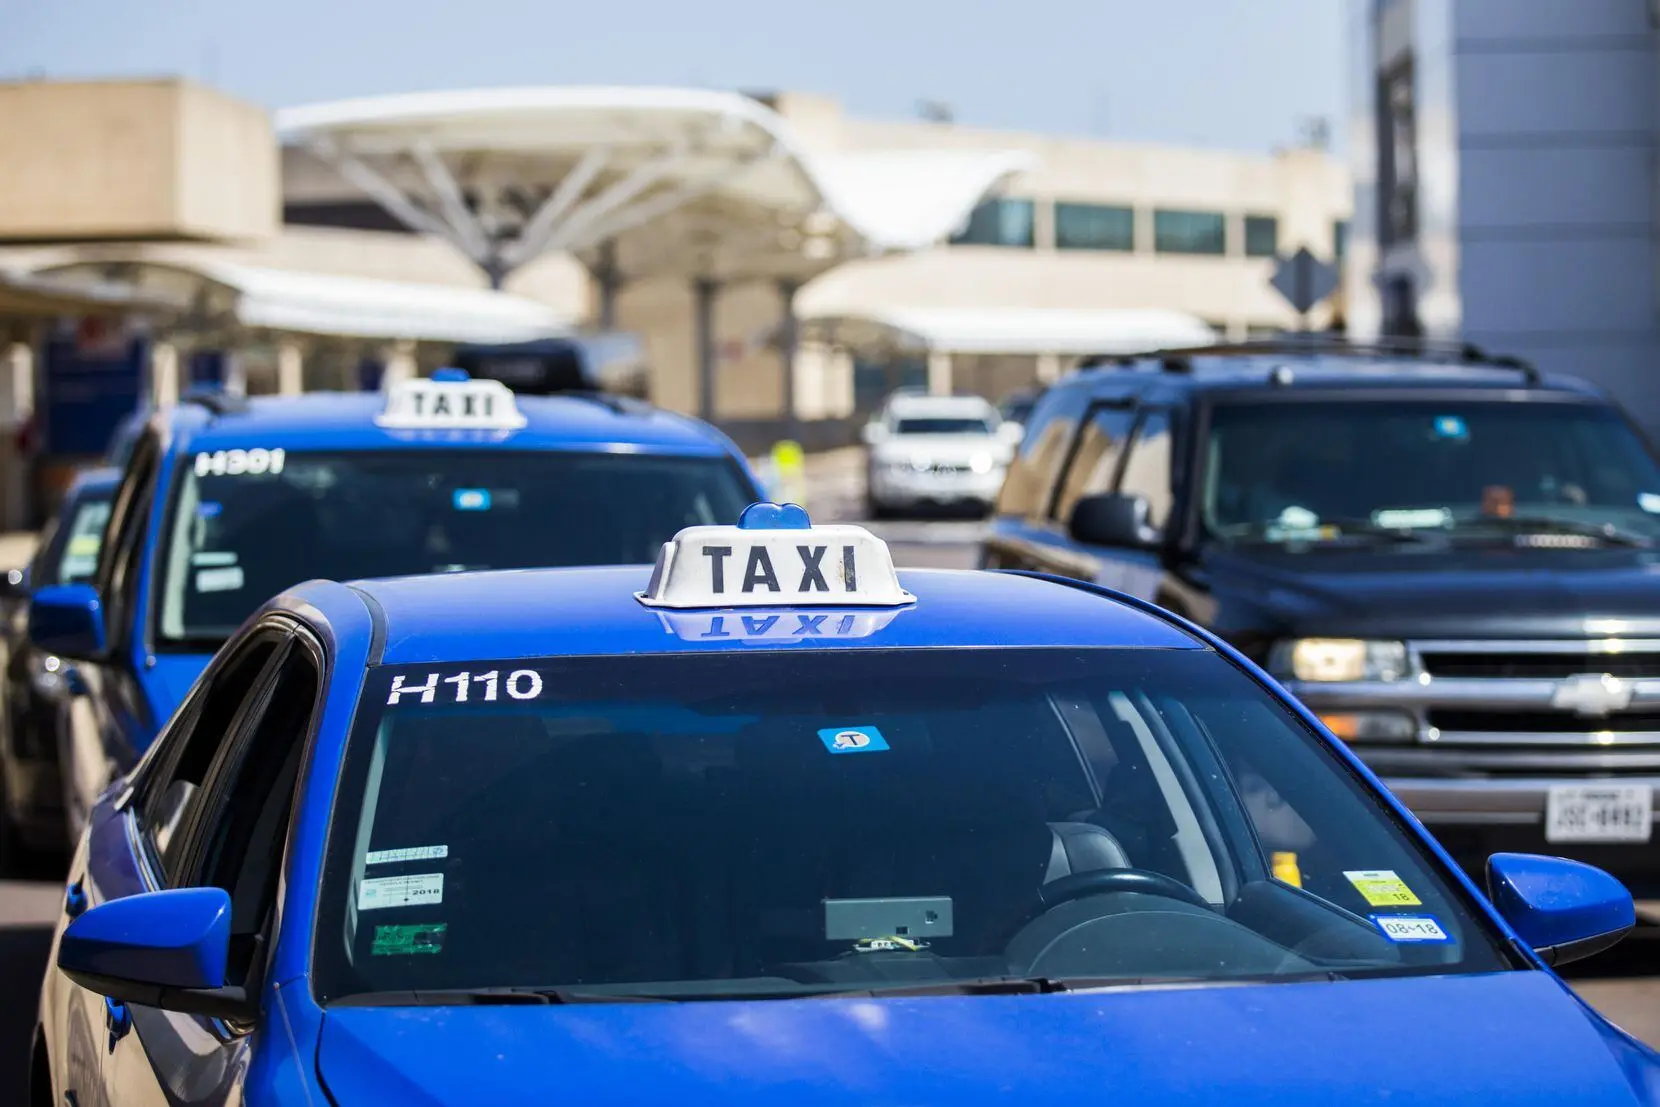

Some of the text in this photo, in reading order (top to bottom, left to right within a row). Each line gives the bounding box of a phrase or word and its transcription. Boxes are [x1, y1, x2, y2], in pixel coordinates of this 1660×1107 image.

[413, 391, 494, 416] TAXI
[702, 545, 857, 594] TAXI
[386, 669, 543, 705] H110
[411, 888, 440, 896] 2018
[1392, 892, 1411, 902] 18
